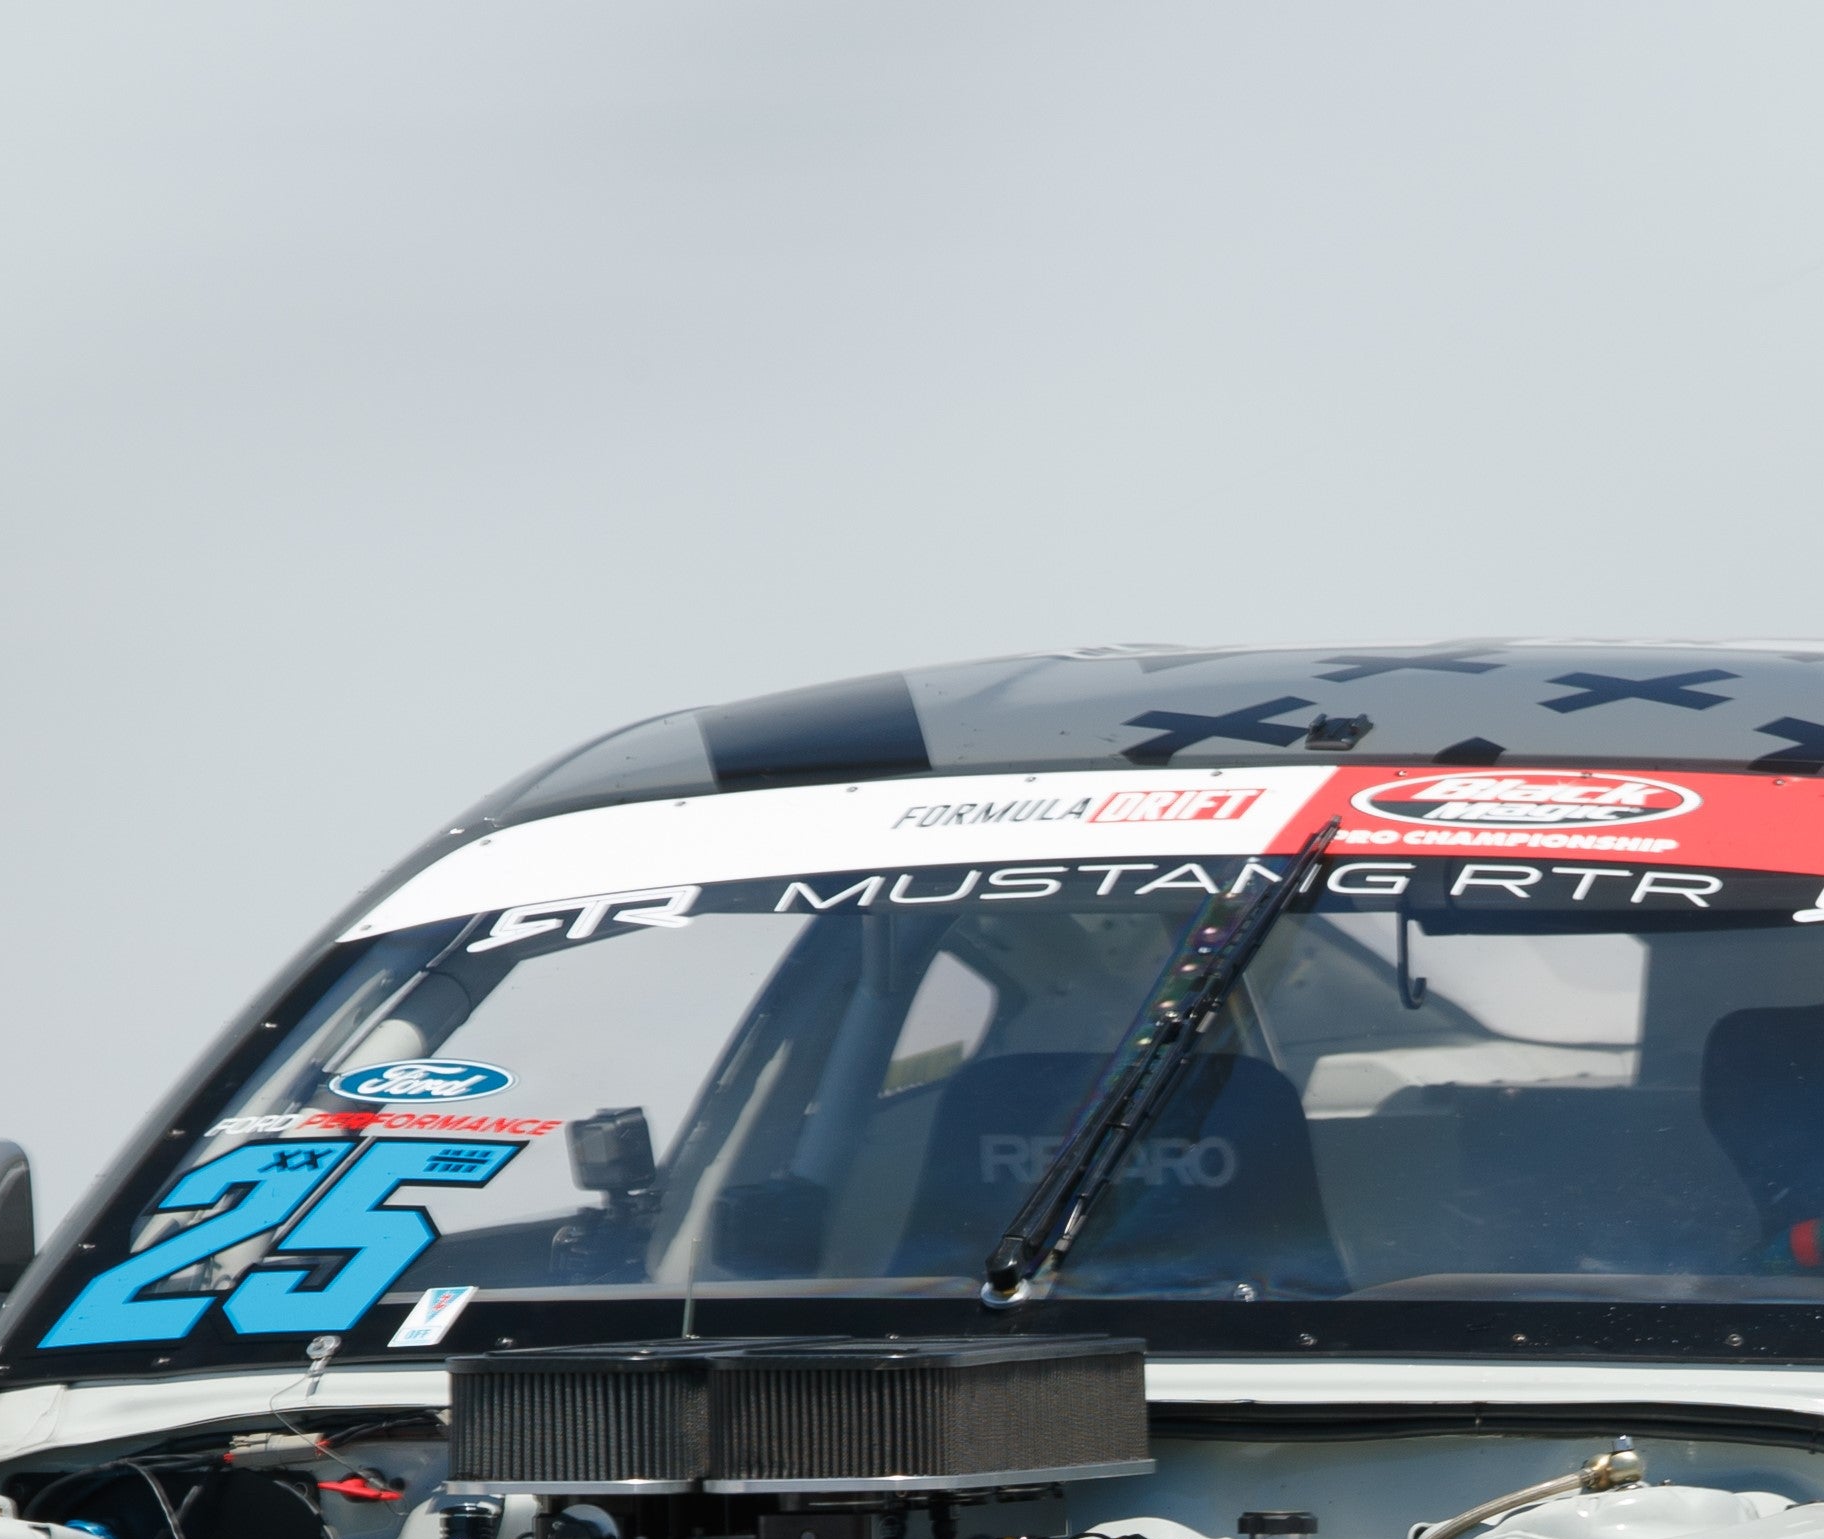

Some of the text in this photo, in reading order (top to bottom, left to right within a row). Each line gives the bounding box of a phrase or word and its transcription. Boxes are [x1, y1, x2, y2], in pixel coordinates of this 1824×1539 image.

[892, 789, 1265, 829] FORMULA DRIFT
[1411, 777, 1670, 806] Black
[1422, 800, 1636, 823] Magic
[1333, 828, 1680, 853] PRO CHAMPIONSHIP
[773, 856, 1725, 912] MUSTANG RTR
[354, 1062, 488, 1099] Ford
[203, 1112, 566, 1137] FORD PERFORMANCE
[980, 1134, 1238, 1187] REARO
[32, 1138, 530, 1352] 25
